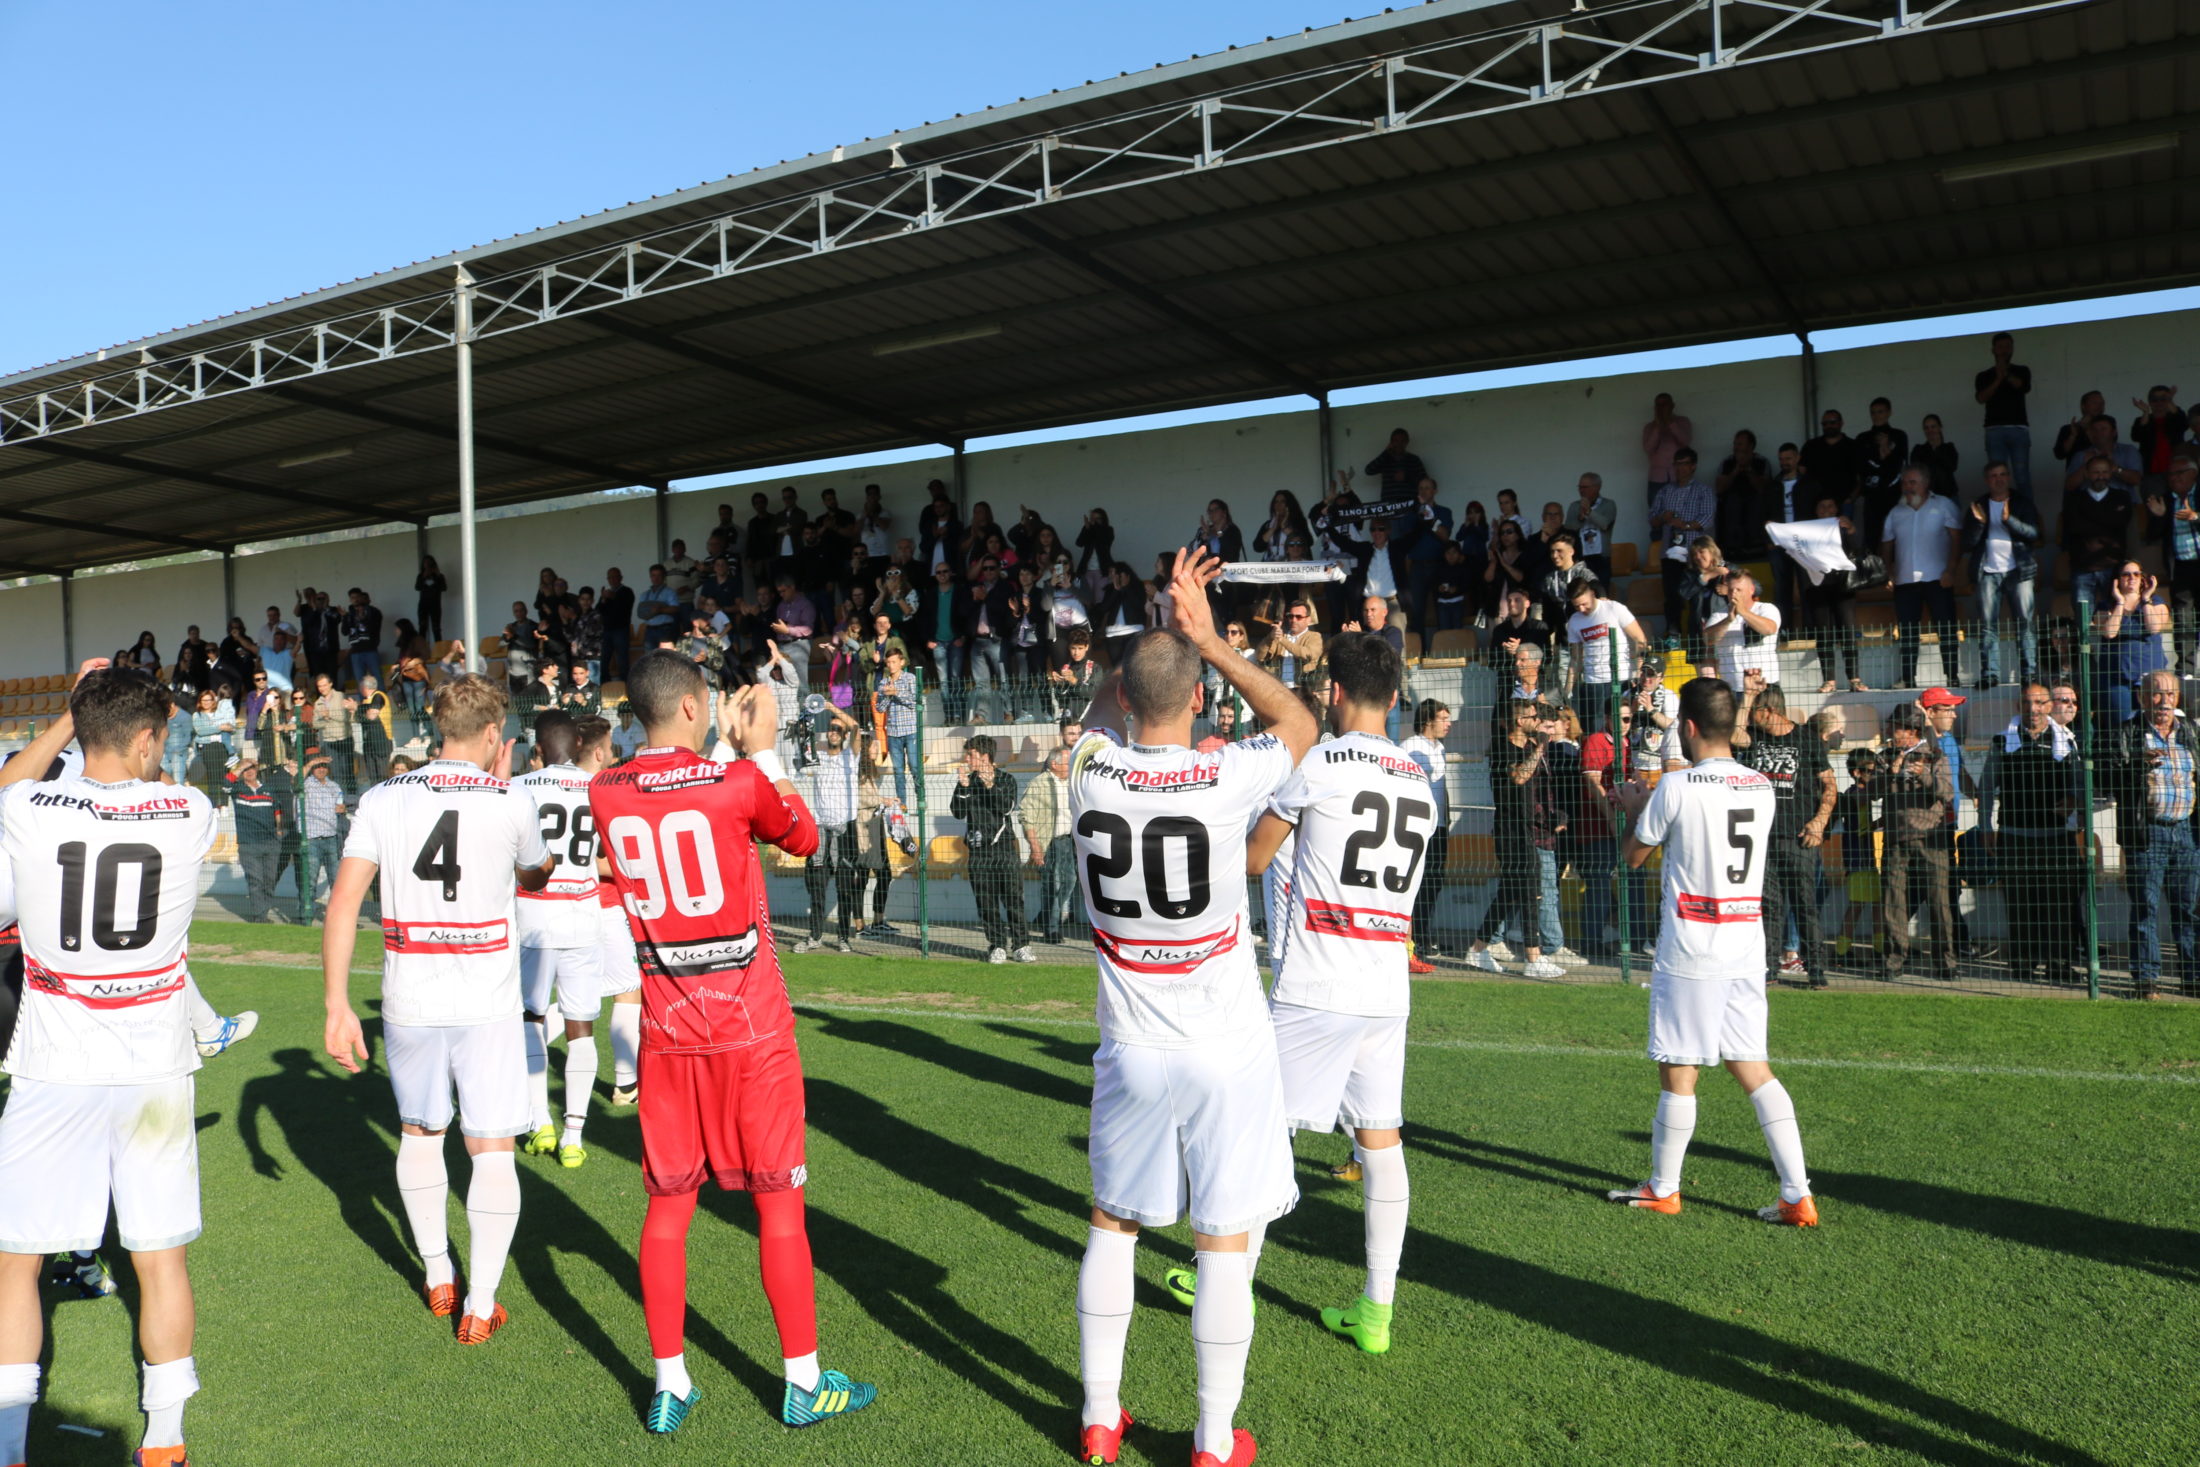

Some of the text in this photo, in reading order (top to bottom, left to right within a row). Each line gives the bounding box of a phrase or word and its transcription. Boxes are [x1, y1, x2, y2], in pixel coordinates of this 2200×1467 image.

[1338, 507, 1368, 517] FONTE
[1370, 505, 1383, 514] DA
[1230, 567, 1248, 575] SPORT
[1250, 567, 1269, 575] CLUBE
[1292, 566, 1301, 574] DA
[1302, 565, 1321, 573] FONTE
[673, 782, 681, 790] DE
[412, 809, 462, 901] 4
[538, 803, 597, 867] 28
[608, 809, 725, 920] 90
[1077, 809, 1211, 920] 20
[1340, 790, 1432, 894] 25
[1726, 808, 1755, 884] 5
[56, 840, 163, 952] 10
[427, 929, 489, 942] Nunes
[670, 944, 743, 966] Nunes
